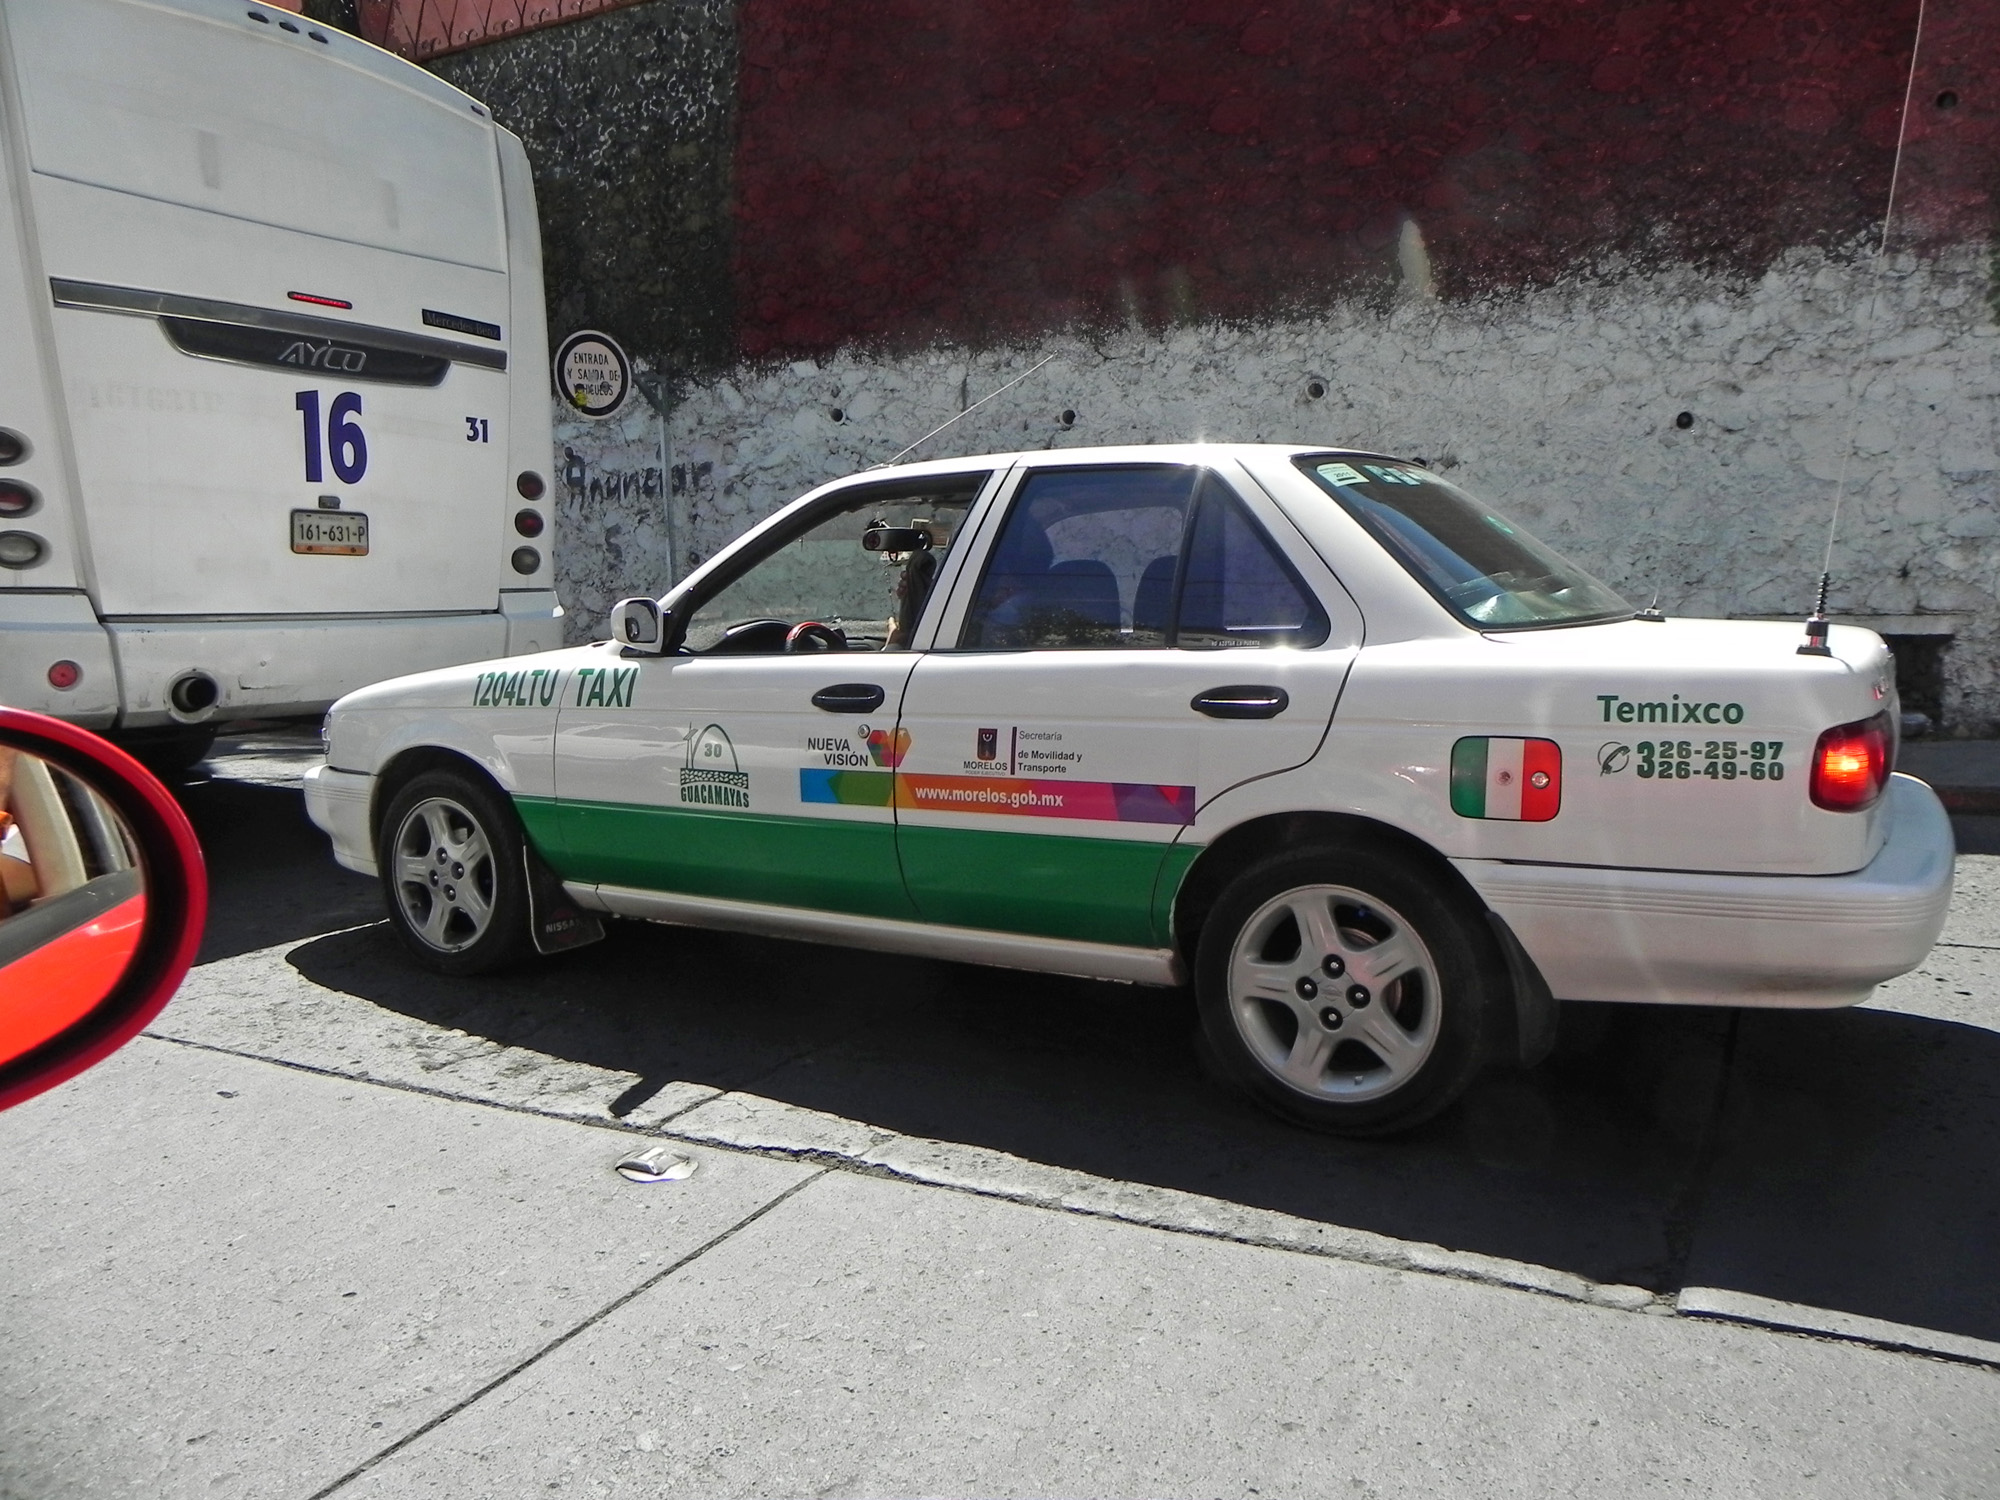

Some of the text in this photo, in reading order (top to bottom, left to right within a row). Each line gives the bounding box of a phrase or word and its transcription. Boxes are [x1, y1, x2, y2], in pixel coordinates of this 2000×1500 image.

[425, 311, 499, 338] Mercedes-Benz
[278, 341, 367, 372] AYCO
[573, 352, 609, 365] ENTRADA
[567, 368, 573, 379] Y
[577, 368, 605, 381] SADA
[295, 389, 368, 485] 16
[465, 416, 489, 443] 31
[299, 524, 366, 543] 161-631-P
[472, 667, 639, 707] 1204LTU TAXI
[1597, 693, 1744, 724] Temixco
[807, 737, 850, 752] NUEVA
[1018, 730, 1062, 741] Secretaría
[704, 743, 722, 758] 30
[824, 751, 868, 767] VISIÓN
[1018, 750, 1082, 763] de Movilidad y
[963, 761, 1008, 771] MORELOS
[1018, 762, 1067, 773] Transporte
[1658, 761, 1784, 780] 26-49-60
[680, 784, 749, 808] GUACAMAYAS
[915, 786, 1064, 808] www.morelos.gob.mx
